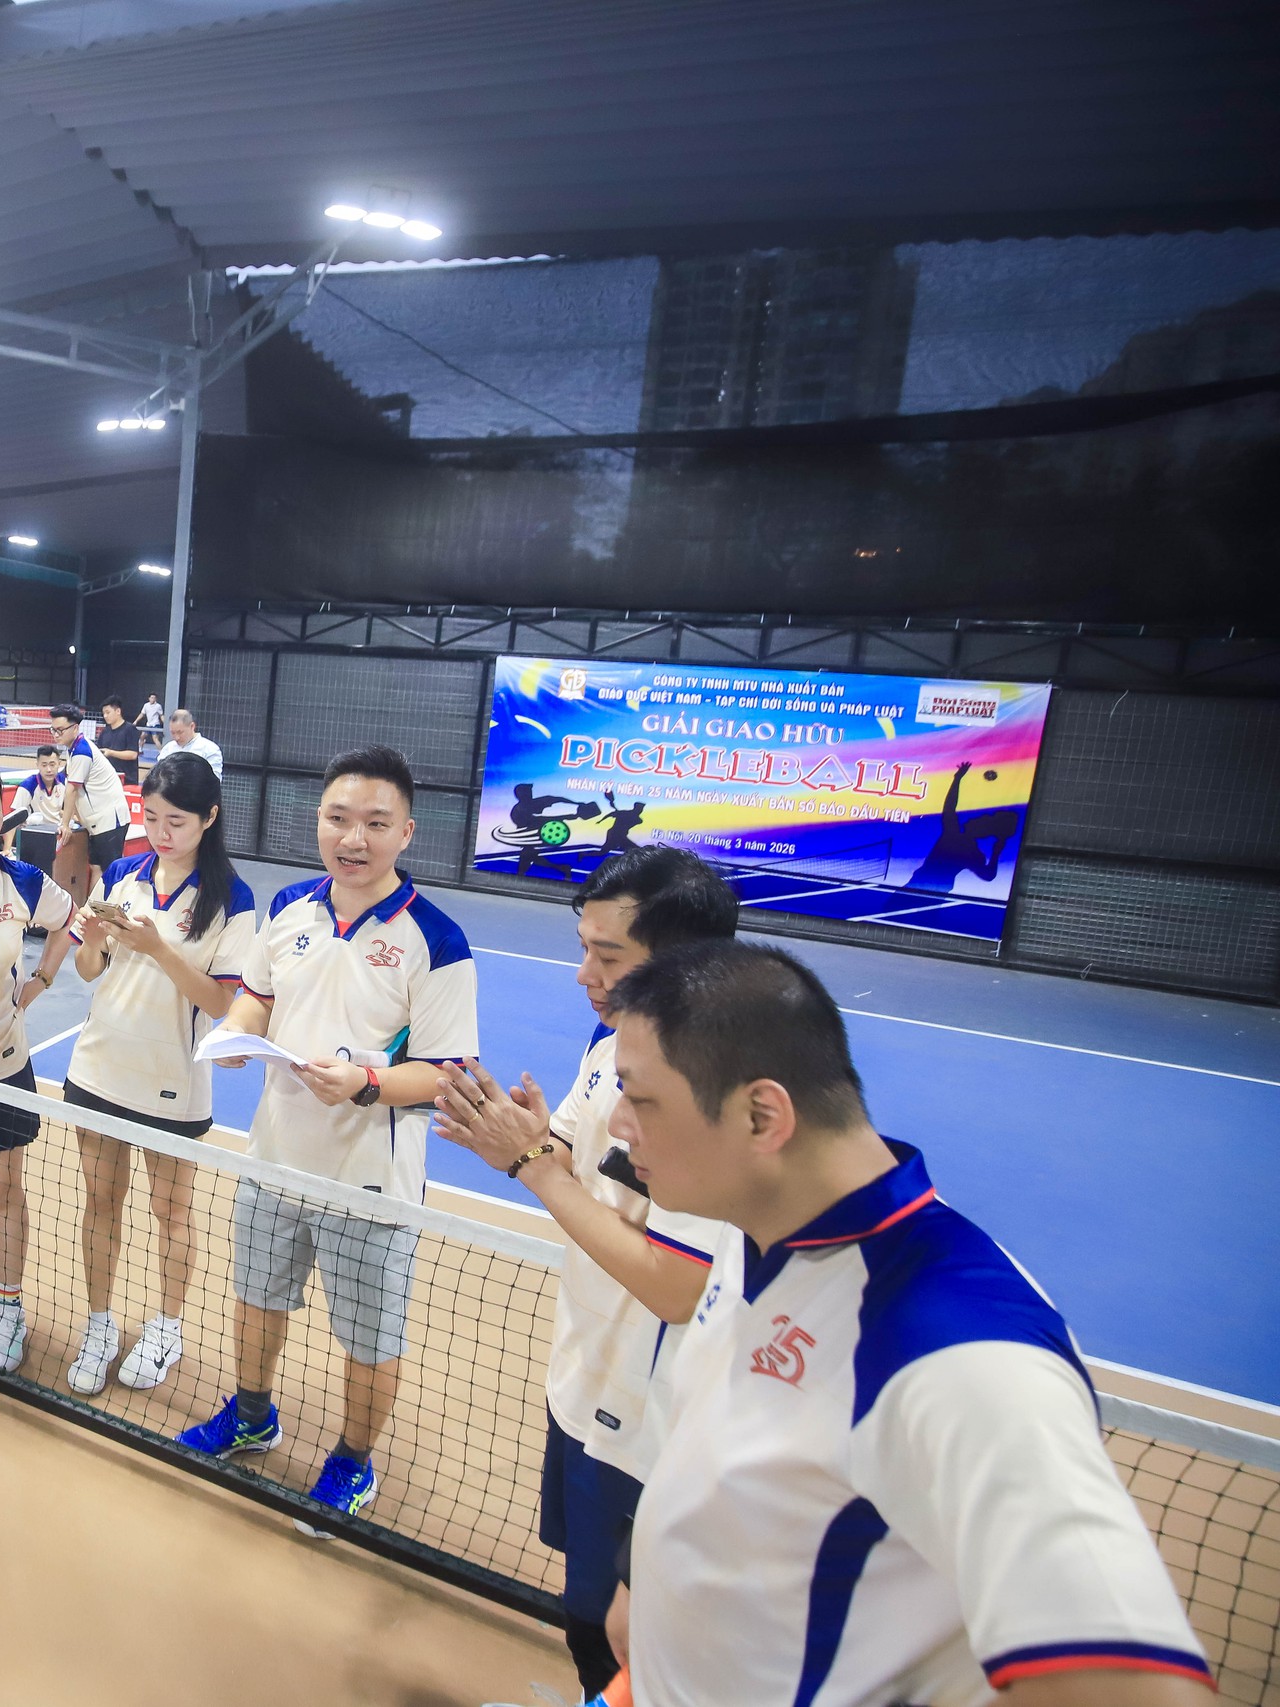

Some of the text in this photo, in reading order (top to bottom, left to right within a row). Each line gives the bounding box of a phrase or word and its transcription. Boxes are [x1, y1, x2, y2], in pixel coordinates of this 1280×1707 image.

[653, 674, 845, 697] CÔNG TY TNHH MTV NHÀ XUẤT BẢN
[598, 687, 623, 700] GIÁO
[650, 690, 673, 705] VIỆT
[676, 693, 702, 705] NAM
[715, 695, 736, 709] TẠP
[738, 695, 758, 709] CHÍ
[785, 697, 817, 712] SỐNG
[820, 699, 835, 714] VÀ
[839, 701, 871, 717] PHÁP
[874, 704, 904, 720] LUẬT
[641, 711, 845, 746] GIẢI GIAO HỮU
[559, 735, 927, 800] PICKLEBALL
[567, 778, 596, 792] NHÂN
[617, 782, 644, 796] NIỆM
[647, 786, 662, 797] 25
[665, 786, 693, 801] NĂM
[696, 788, 727, 805] NGÀY
[732, 792, 764, 809] XUẤT
[768, 796, 795, 812] BẢN
[798, 797, 816, 813] SỐ
[819, 801, 846, 817] BÁO
[850, 804, 879, 820] ĐẦU
[883, 808, 910, 824] TIÊN
[688, 834, 701, 844] 20
[704, 834, 732, 849] tháng
[734, 839, 742, 848] 3
[744, 840, 766, 852] năm
[769, 843, 796, 855] 2026
[365, 939, 405, 968] 25
